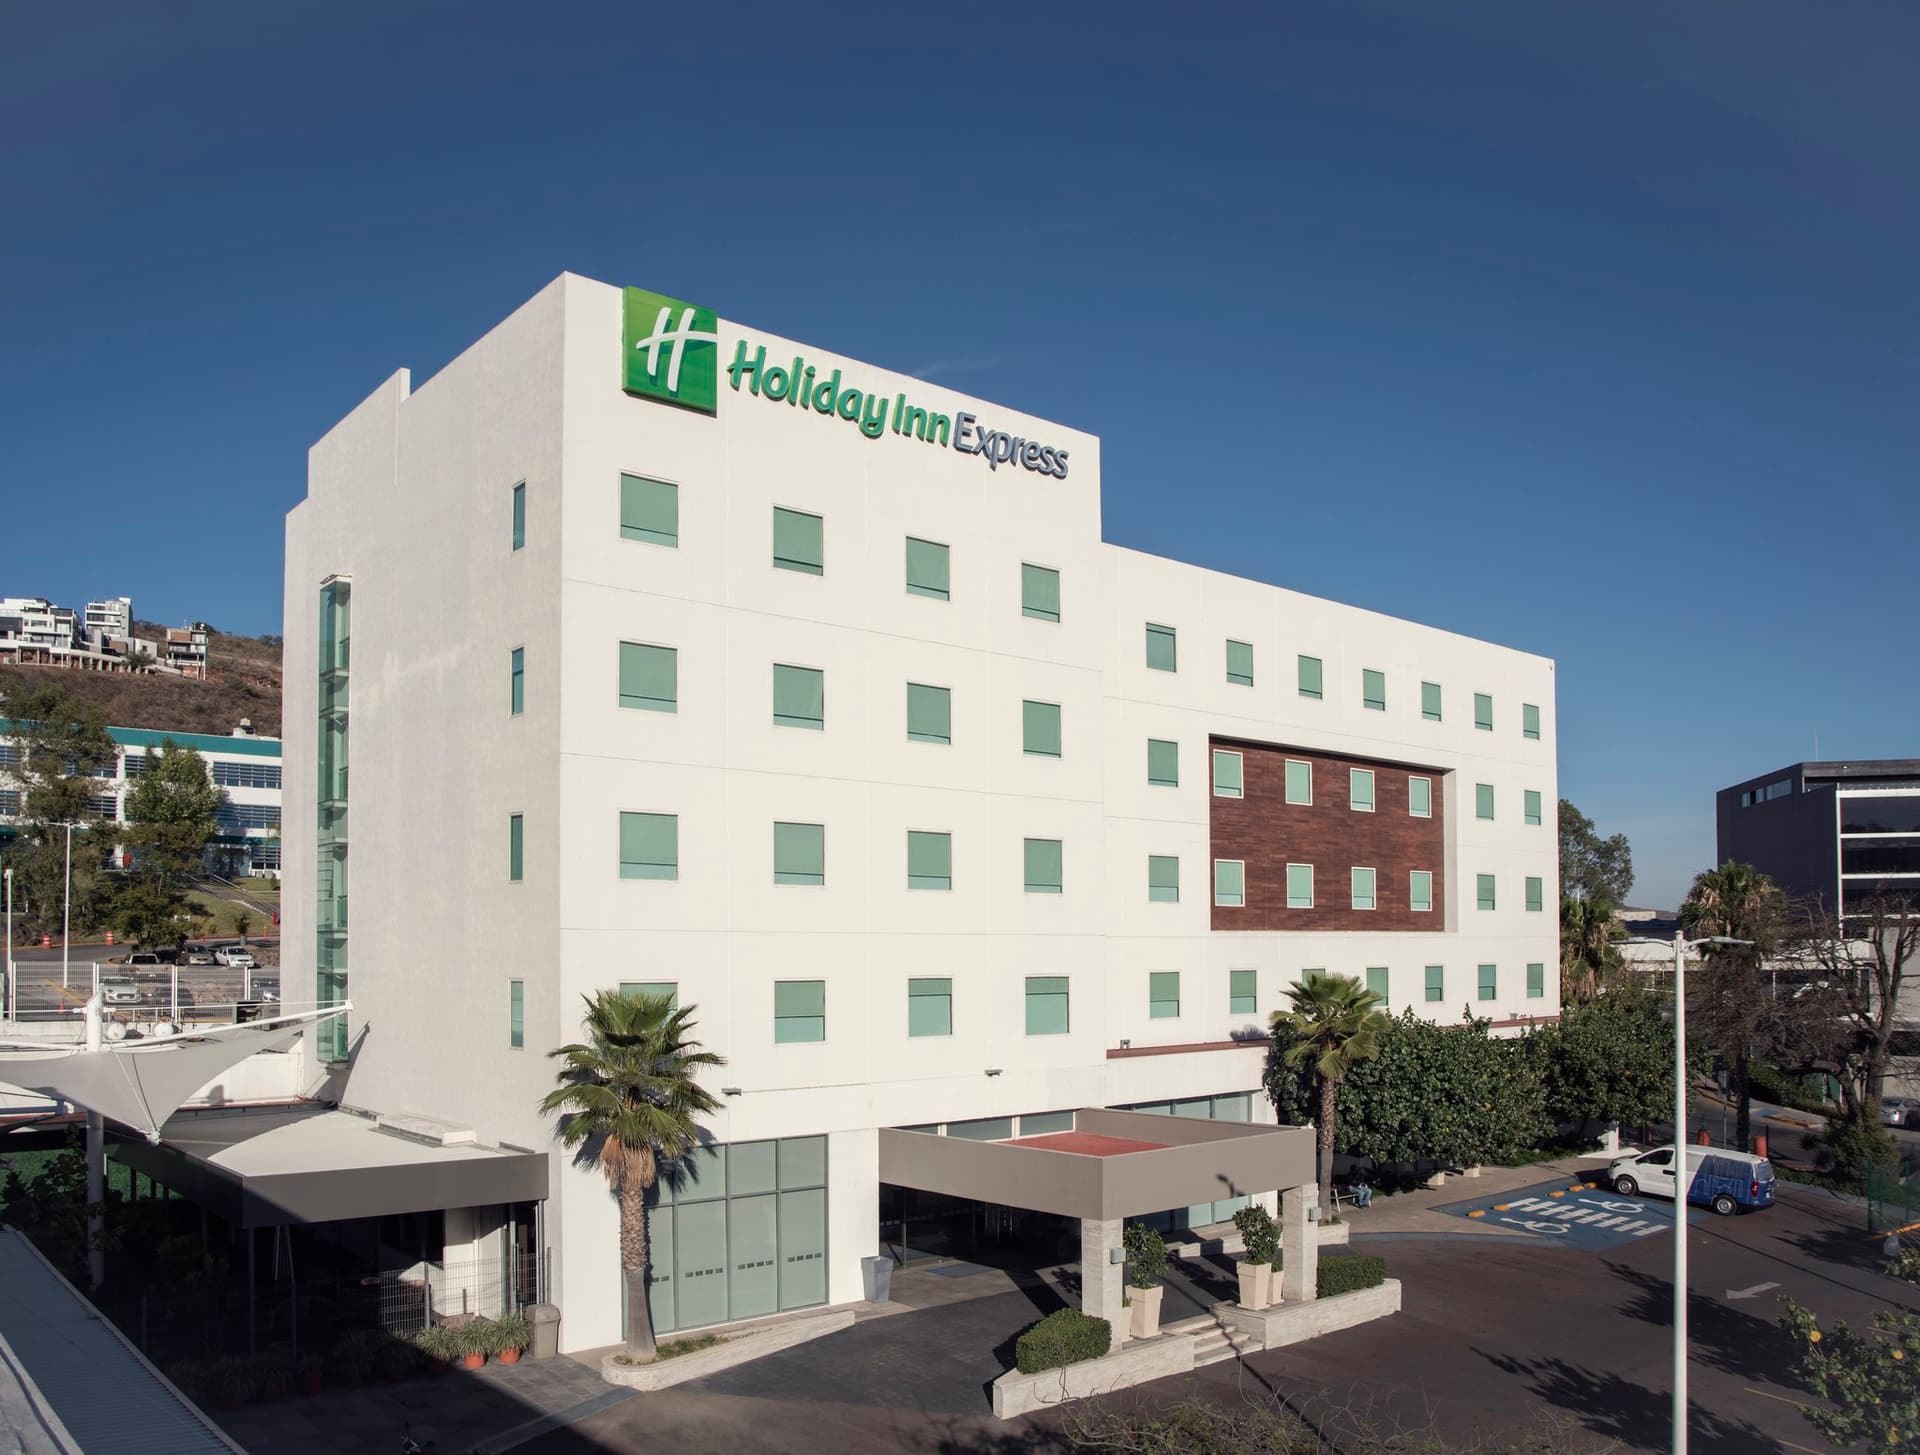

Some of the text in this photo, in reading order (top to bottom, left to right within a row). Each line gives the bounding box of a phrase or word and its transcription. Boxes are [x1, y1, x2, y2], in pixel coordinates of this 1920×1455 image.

[727, 340, 1070, 479] Holiday Inn Express
